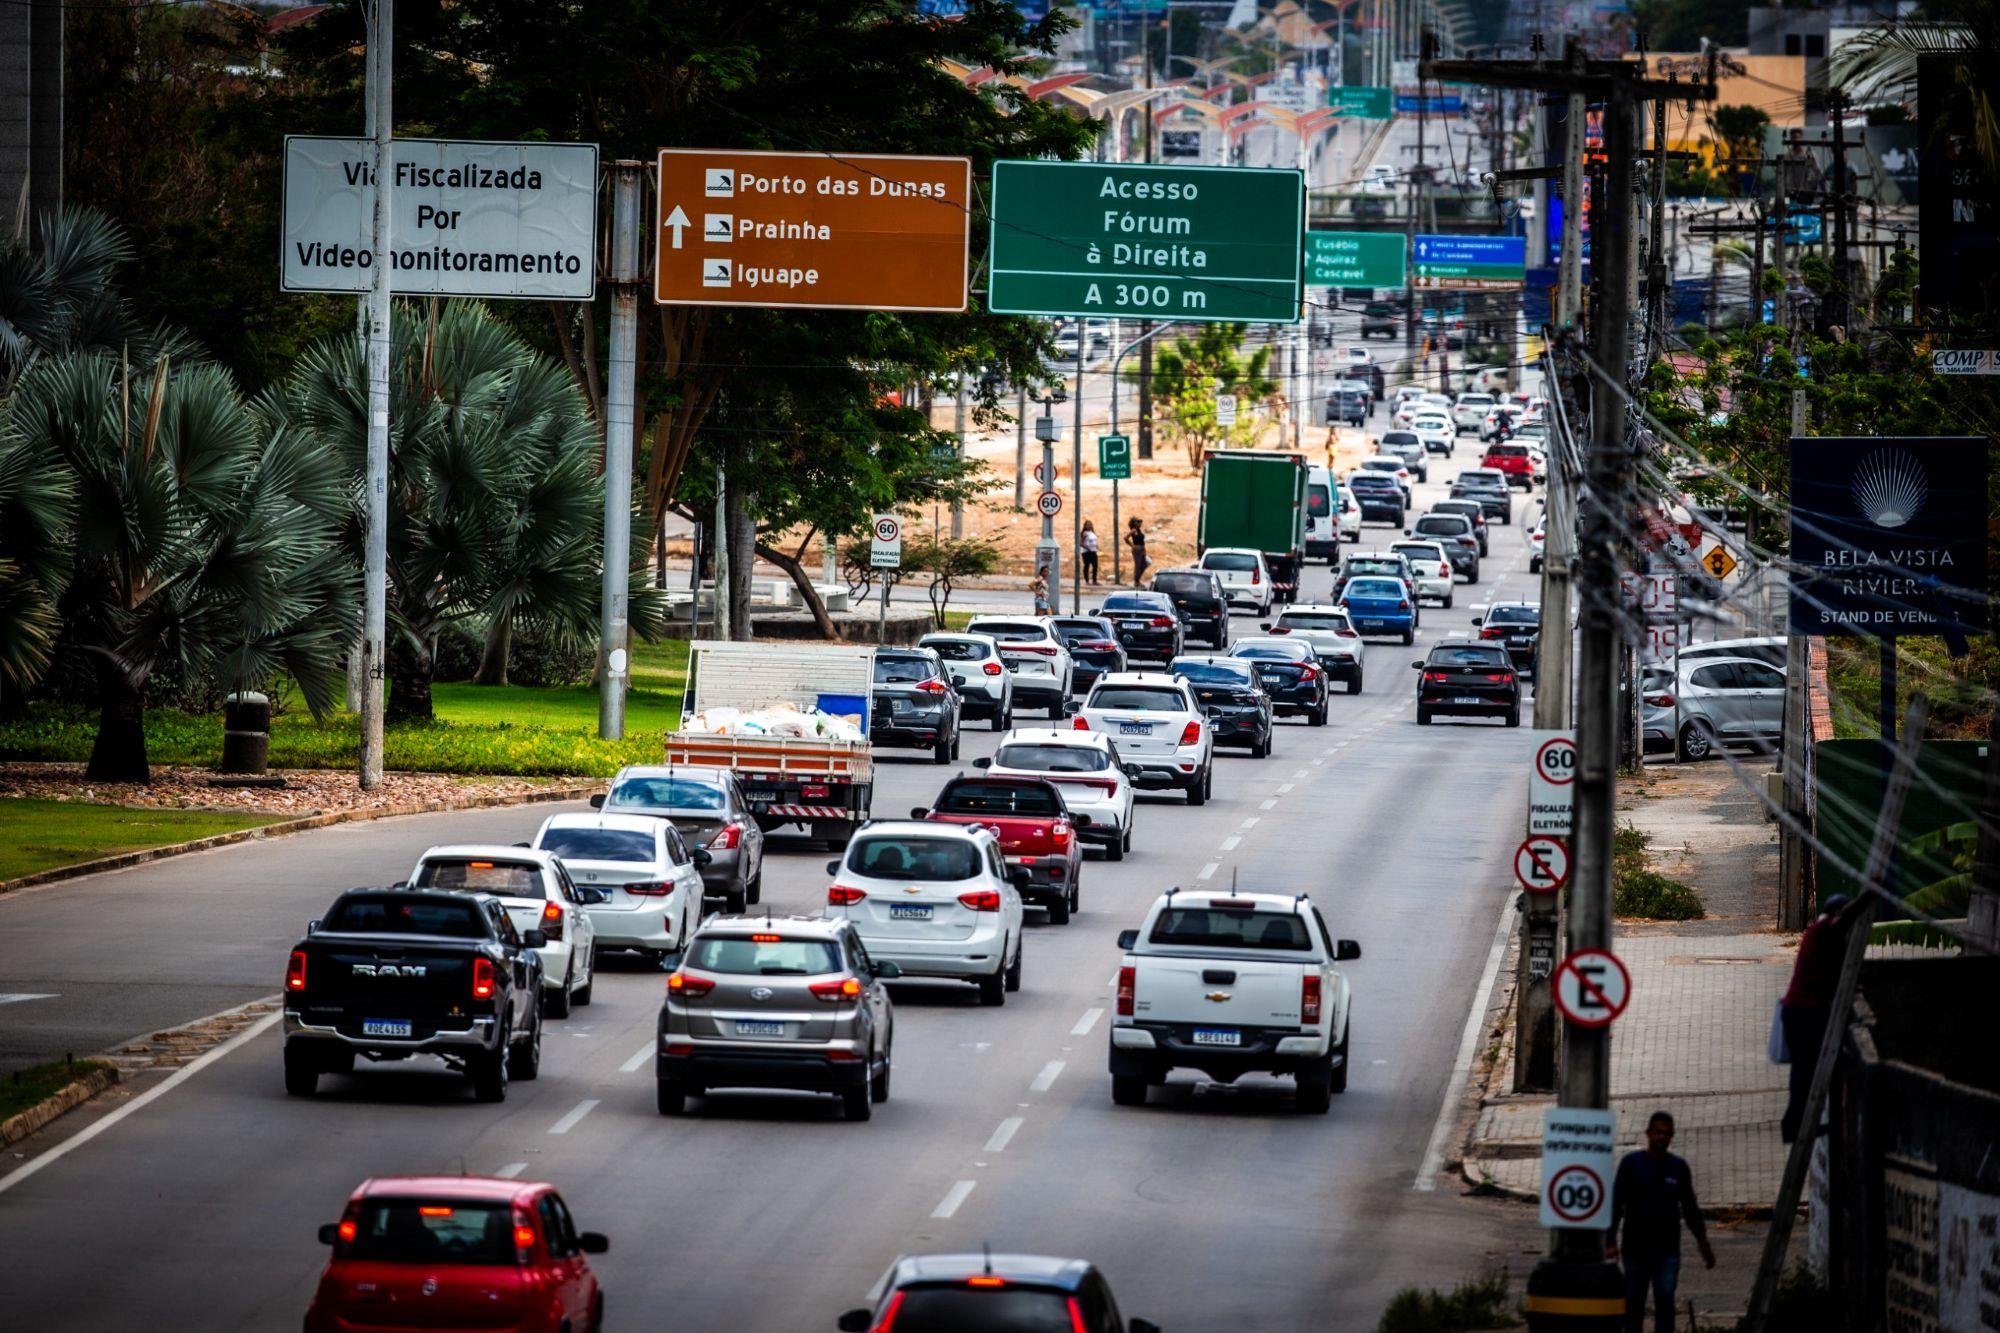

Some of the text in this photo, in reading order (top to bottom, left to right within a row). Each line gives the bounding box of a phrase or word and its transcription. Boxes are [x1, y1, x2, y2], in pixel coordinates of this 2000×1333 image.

[396, 162, 542, 190] Fiscalizada
[740, 173, 946, 198] Porto das Dunas
[1100, 176, 1198, 200] Acesso
[418, 205, 460, 230] Por
[1104, 211, 1190, 234] Fórum
[739, 219, 831, 240] Prainha
[1086, 243, 1207, 267] à Direita
[737, 264, 819, 288] Iguape
[1315, 268, 1365, 278] Cascavel
[1084, 284, 1206, 309] A 300 m
[1041, 496, 1058, 508] 60
[880, 524, 894, 533] 60
[1824, 550, 1954, 566] BELA VISTA
[1843, 579, 1924, 595] RIVIER
[1820, 612, 1869, 623] STAND
[1874, 612, 1894, 623] DE
[1544, 749, 1575, 768] 60
[352, 965, 426, 977] RAM
